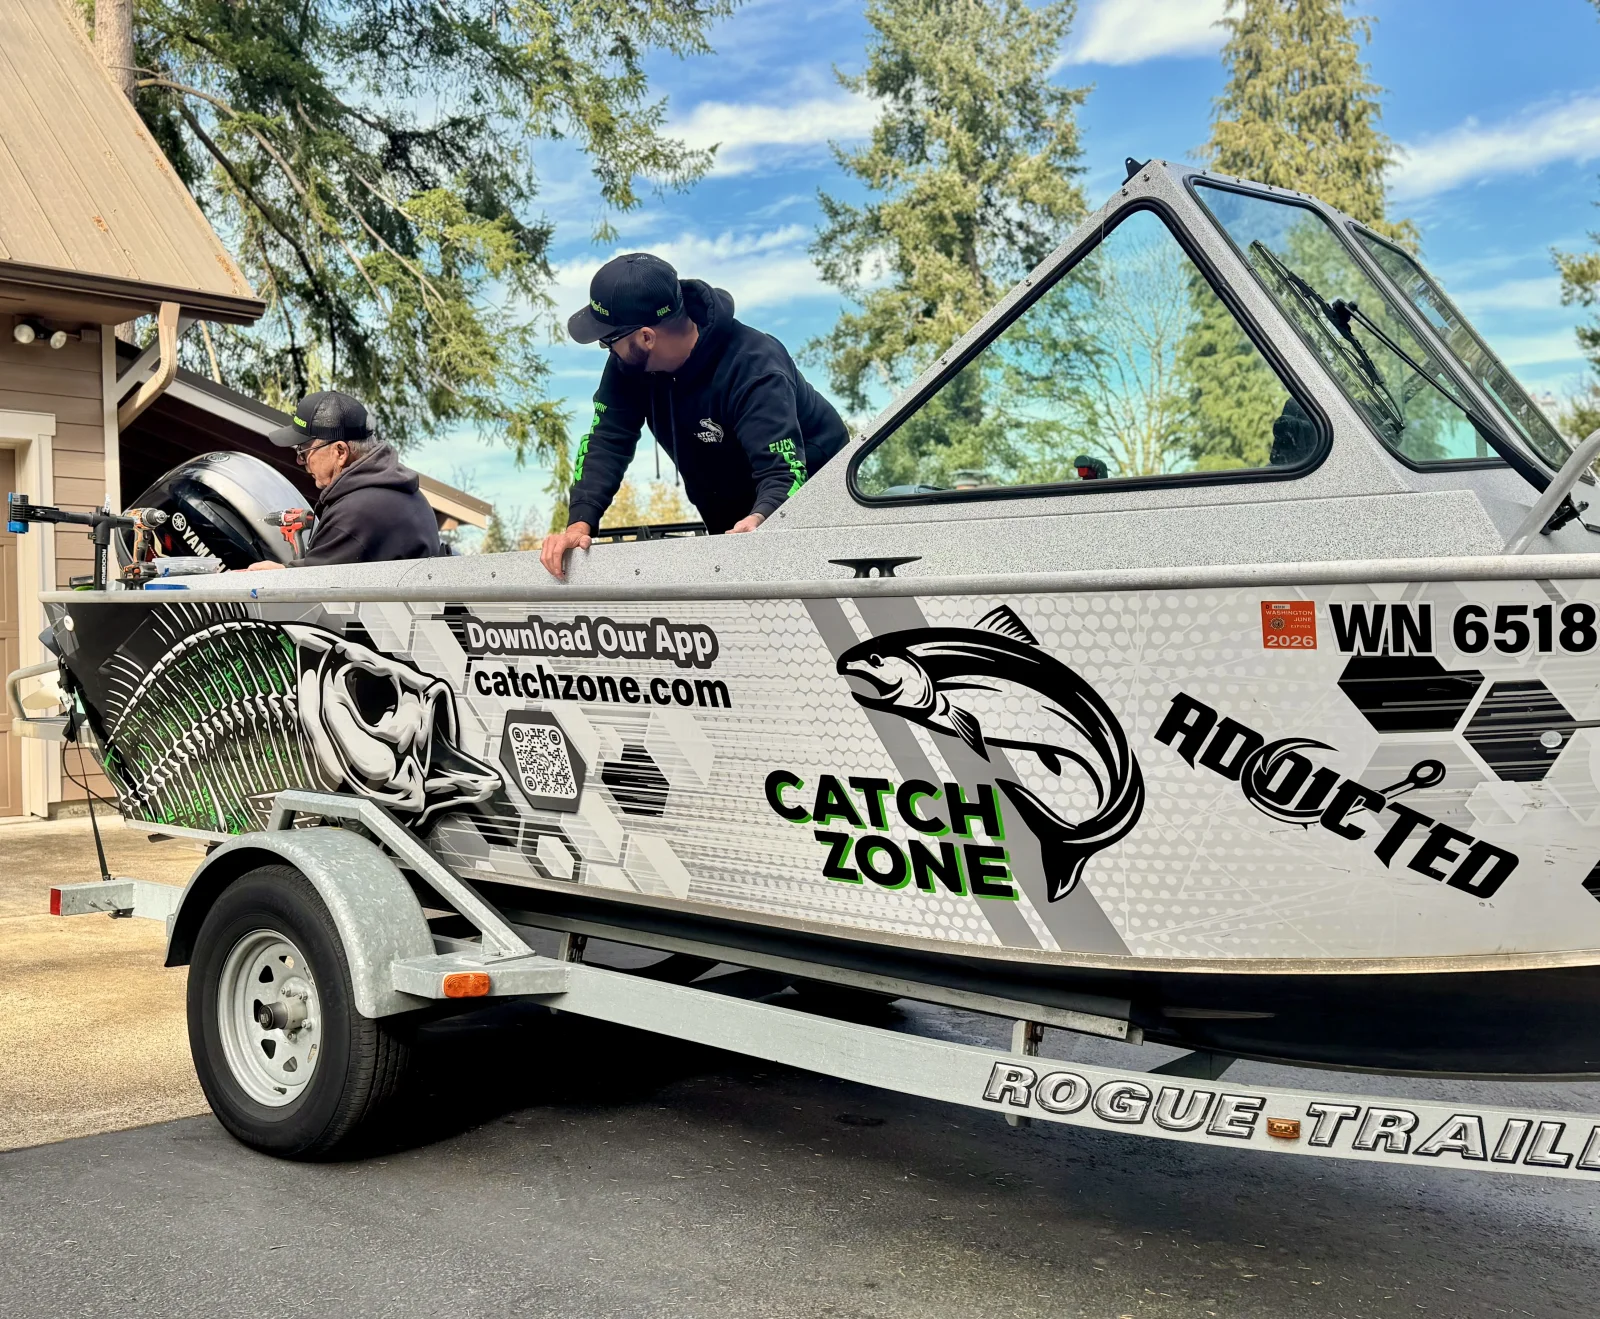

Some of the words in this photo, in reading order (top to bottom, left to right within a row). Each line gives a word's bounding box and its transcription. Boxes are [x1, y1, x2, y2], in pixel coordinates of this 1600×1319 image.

[769, 438, 796, 453] FUCK
[466, 622, 593, 652] Download
[597, 623, 648, 653] Our
[656, 625, 713, 661] App
[1266, 634, 1315, 647] 2026
[1328, 603, 1432, 653] WN
[1453, 603, 1598, 653] 6518
[474, 664, 732, 708] catchzone.com
[765, 770, 1005, 840] CATCH
[1153, 691, 1520, 899] ADDICTED
[814, 830, 1019, 901] ZONE
[982, 1061, 1267, 1139] ROGUE
